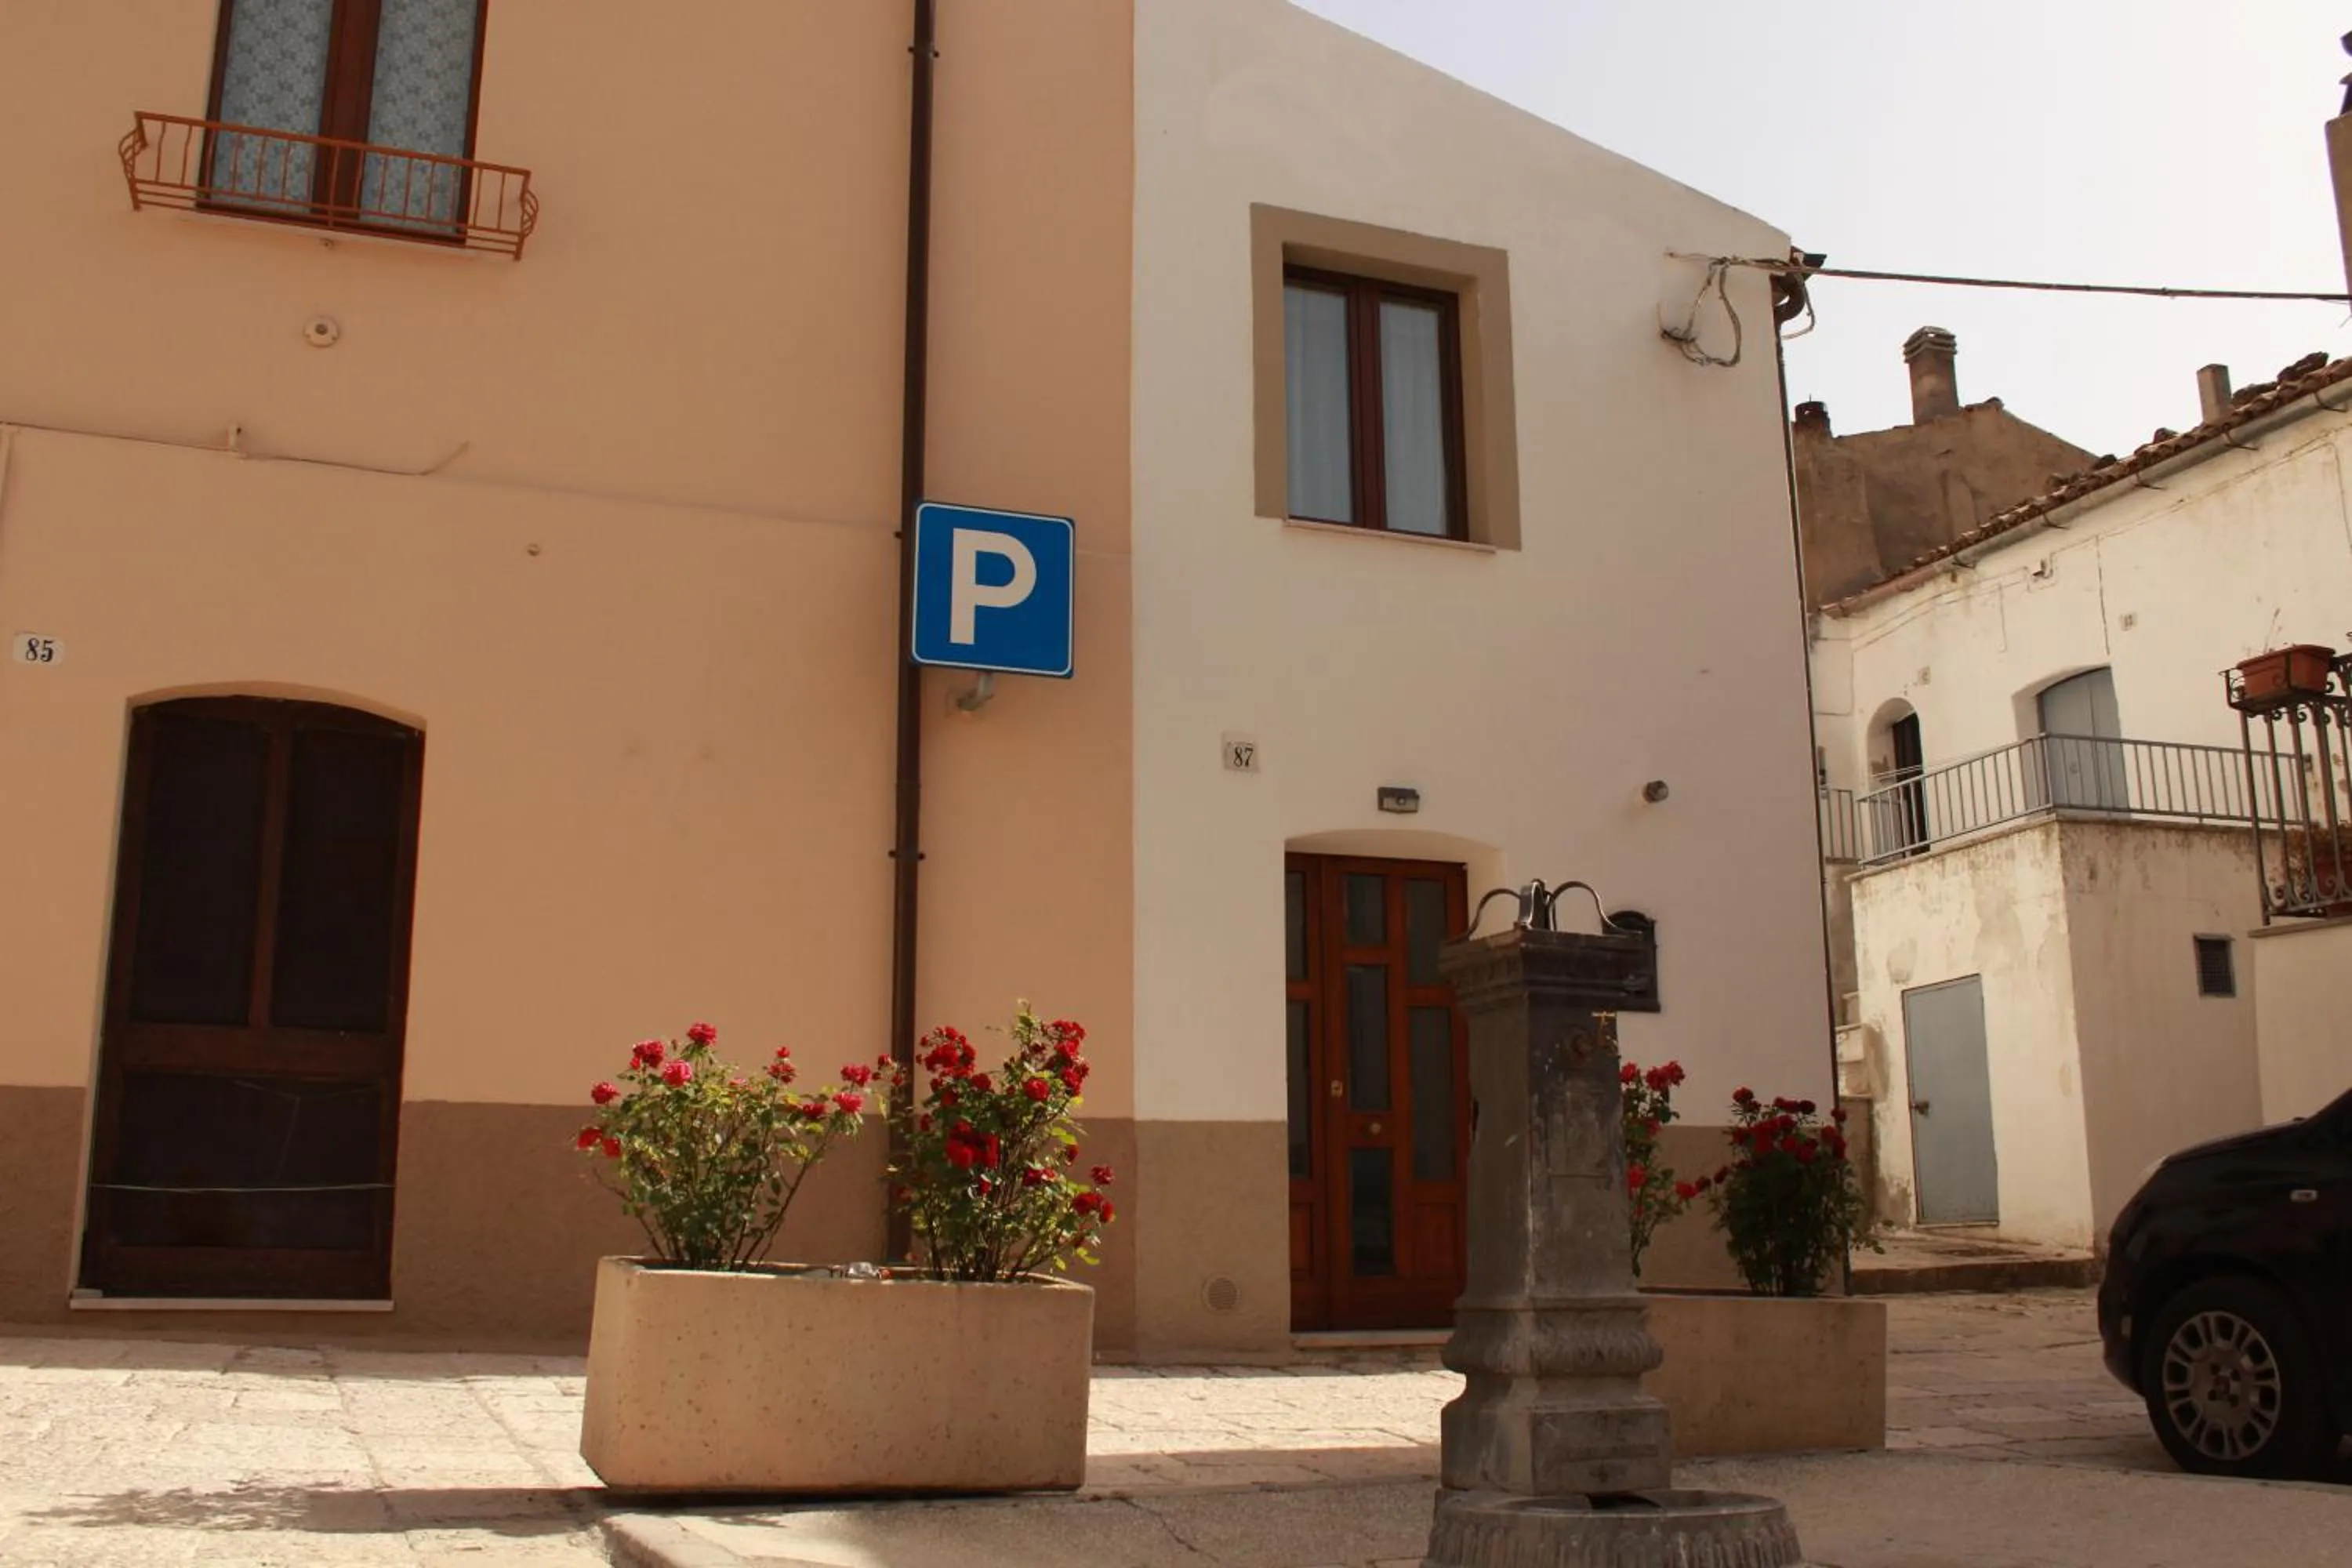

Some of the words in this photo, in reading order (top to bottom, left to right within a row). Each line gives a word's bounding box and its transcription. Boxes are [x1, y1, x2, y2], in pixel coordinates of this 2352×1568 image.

[949, 528, 1037, 644] P
[26, 637, 54, 662] 85
[1233, 746, 1254, 768] 87
